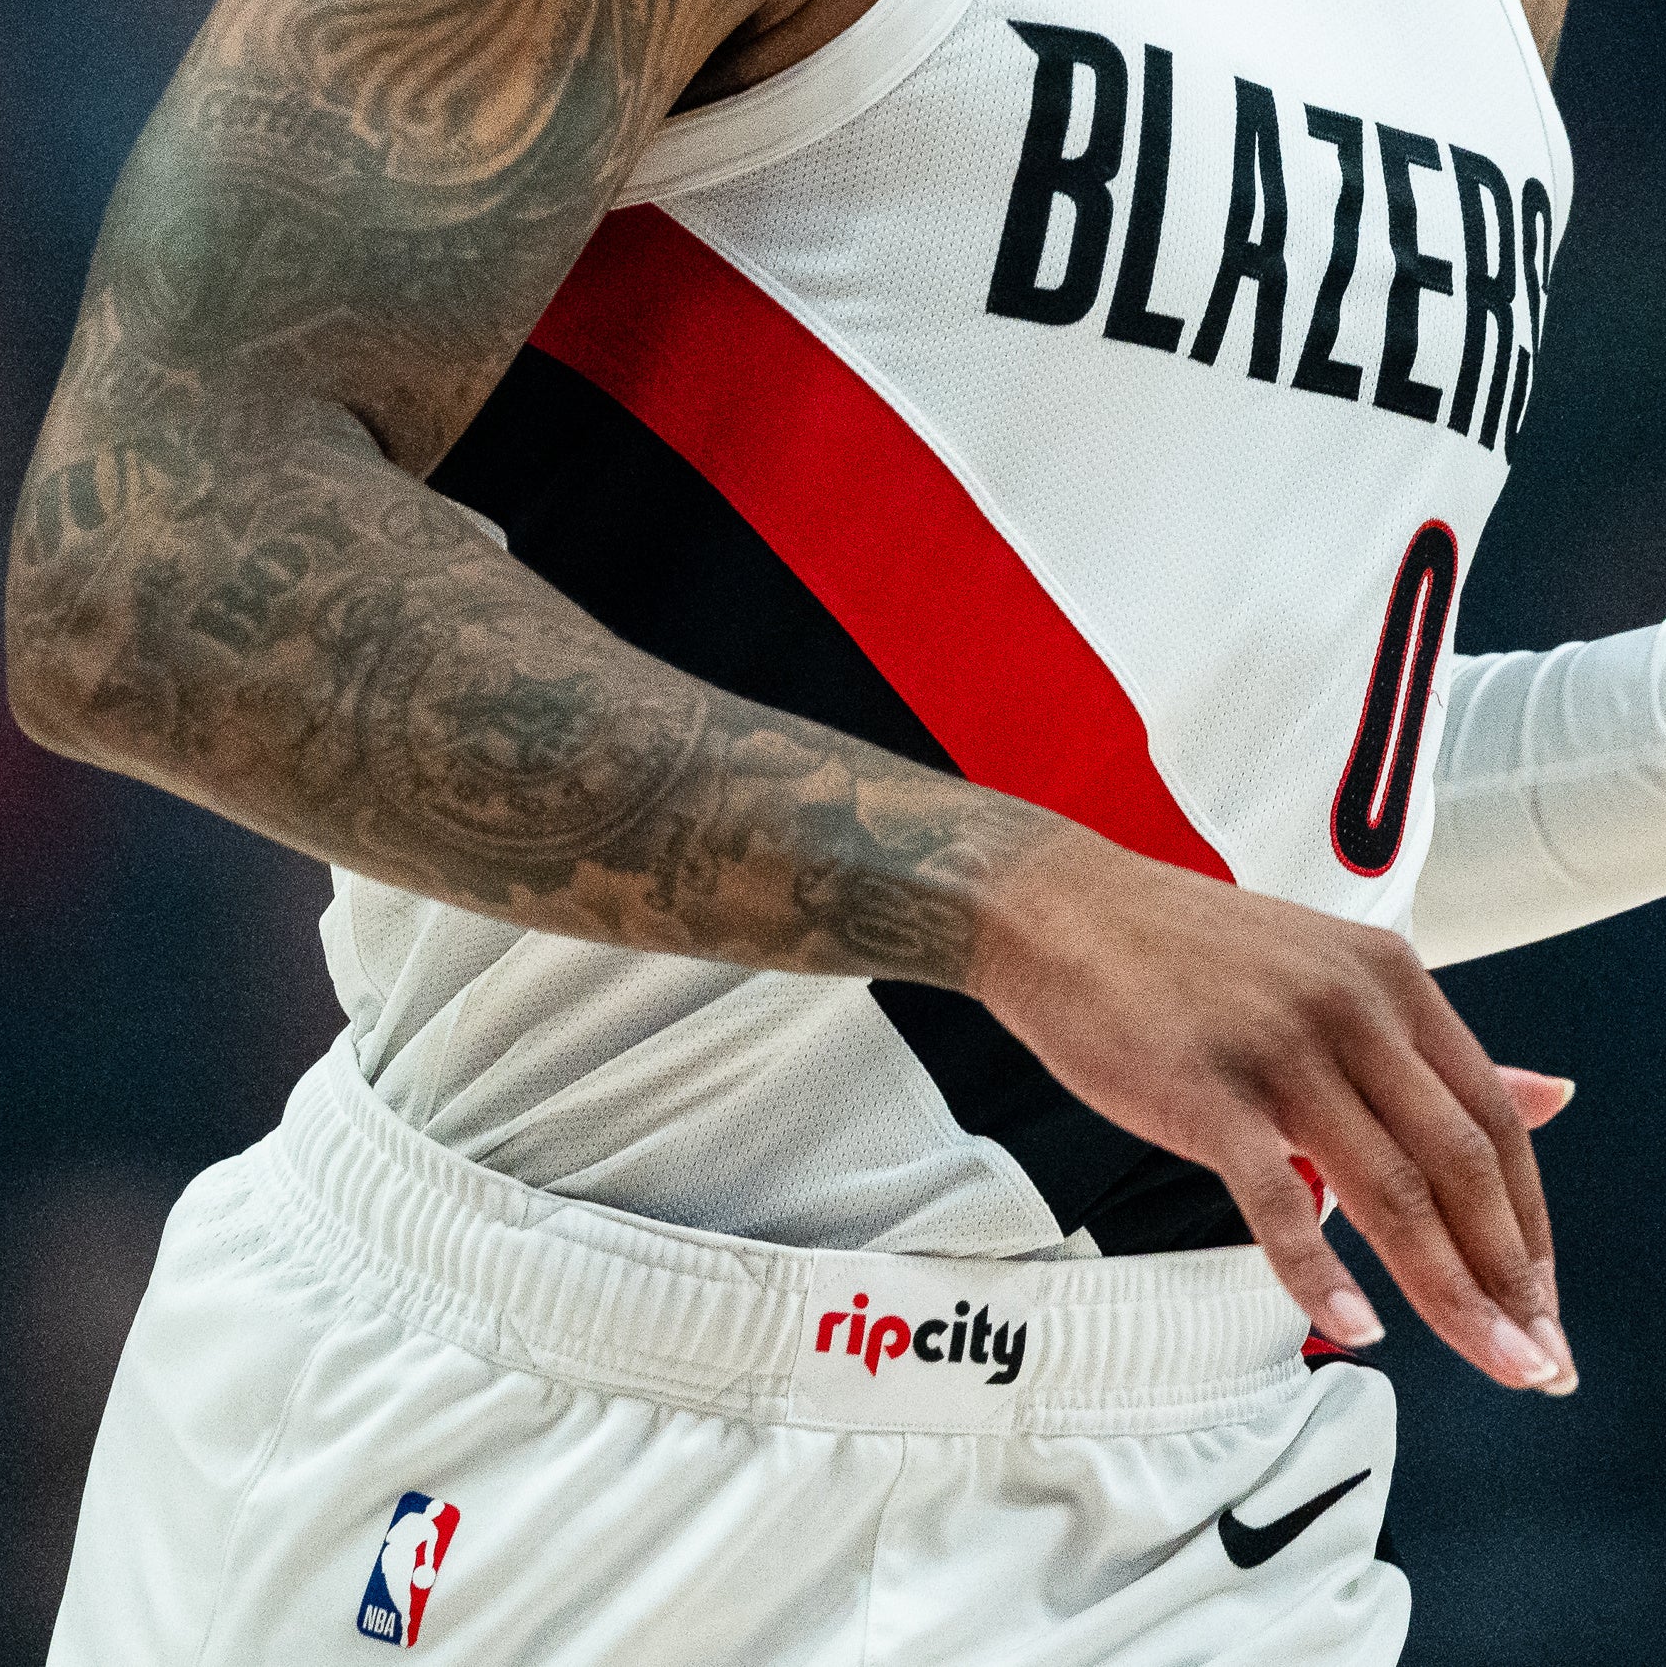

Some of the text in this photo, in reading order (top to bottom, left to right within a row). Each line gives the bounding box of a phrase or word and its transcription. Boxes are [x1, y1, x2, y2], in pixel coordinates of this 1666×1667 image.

[1330, 517, 1458, 878] 0
[815, 1292, 1027, 1385] ripcity
[362, 1604, 397, 1638] NBA
